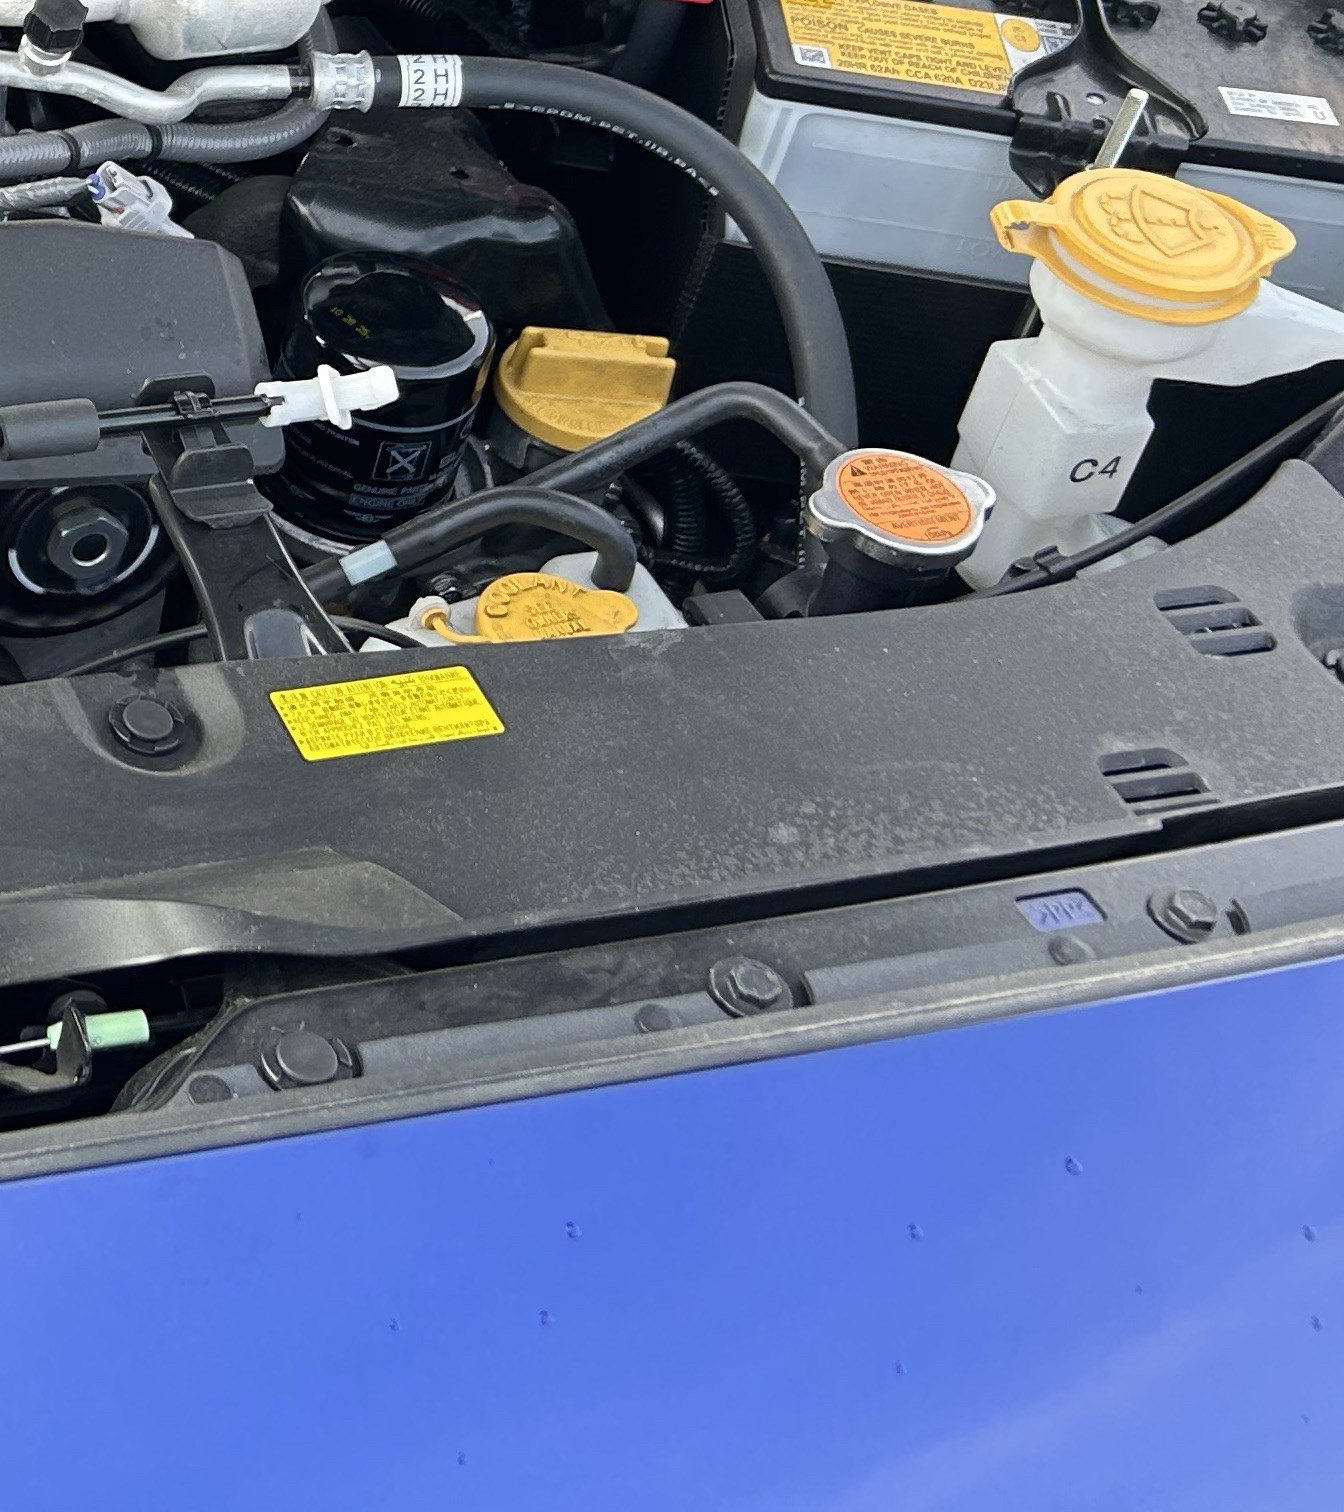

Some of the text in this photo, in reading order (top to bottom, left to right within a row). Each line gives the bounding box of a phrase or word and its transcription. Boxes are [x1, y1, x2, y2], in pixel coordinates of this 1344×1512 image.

[790, 15, 849, 31] POISON
[414, 69, 449, 85] 2 H
[905, 68, 932, 81] CCA
[413, 88, 449, 101] 2 H
[1069, 455, 1122, 483] C4
[484, 576, 588, 619] COOLANT
